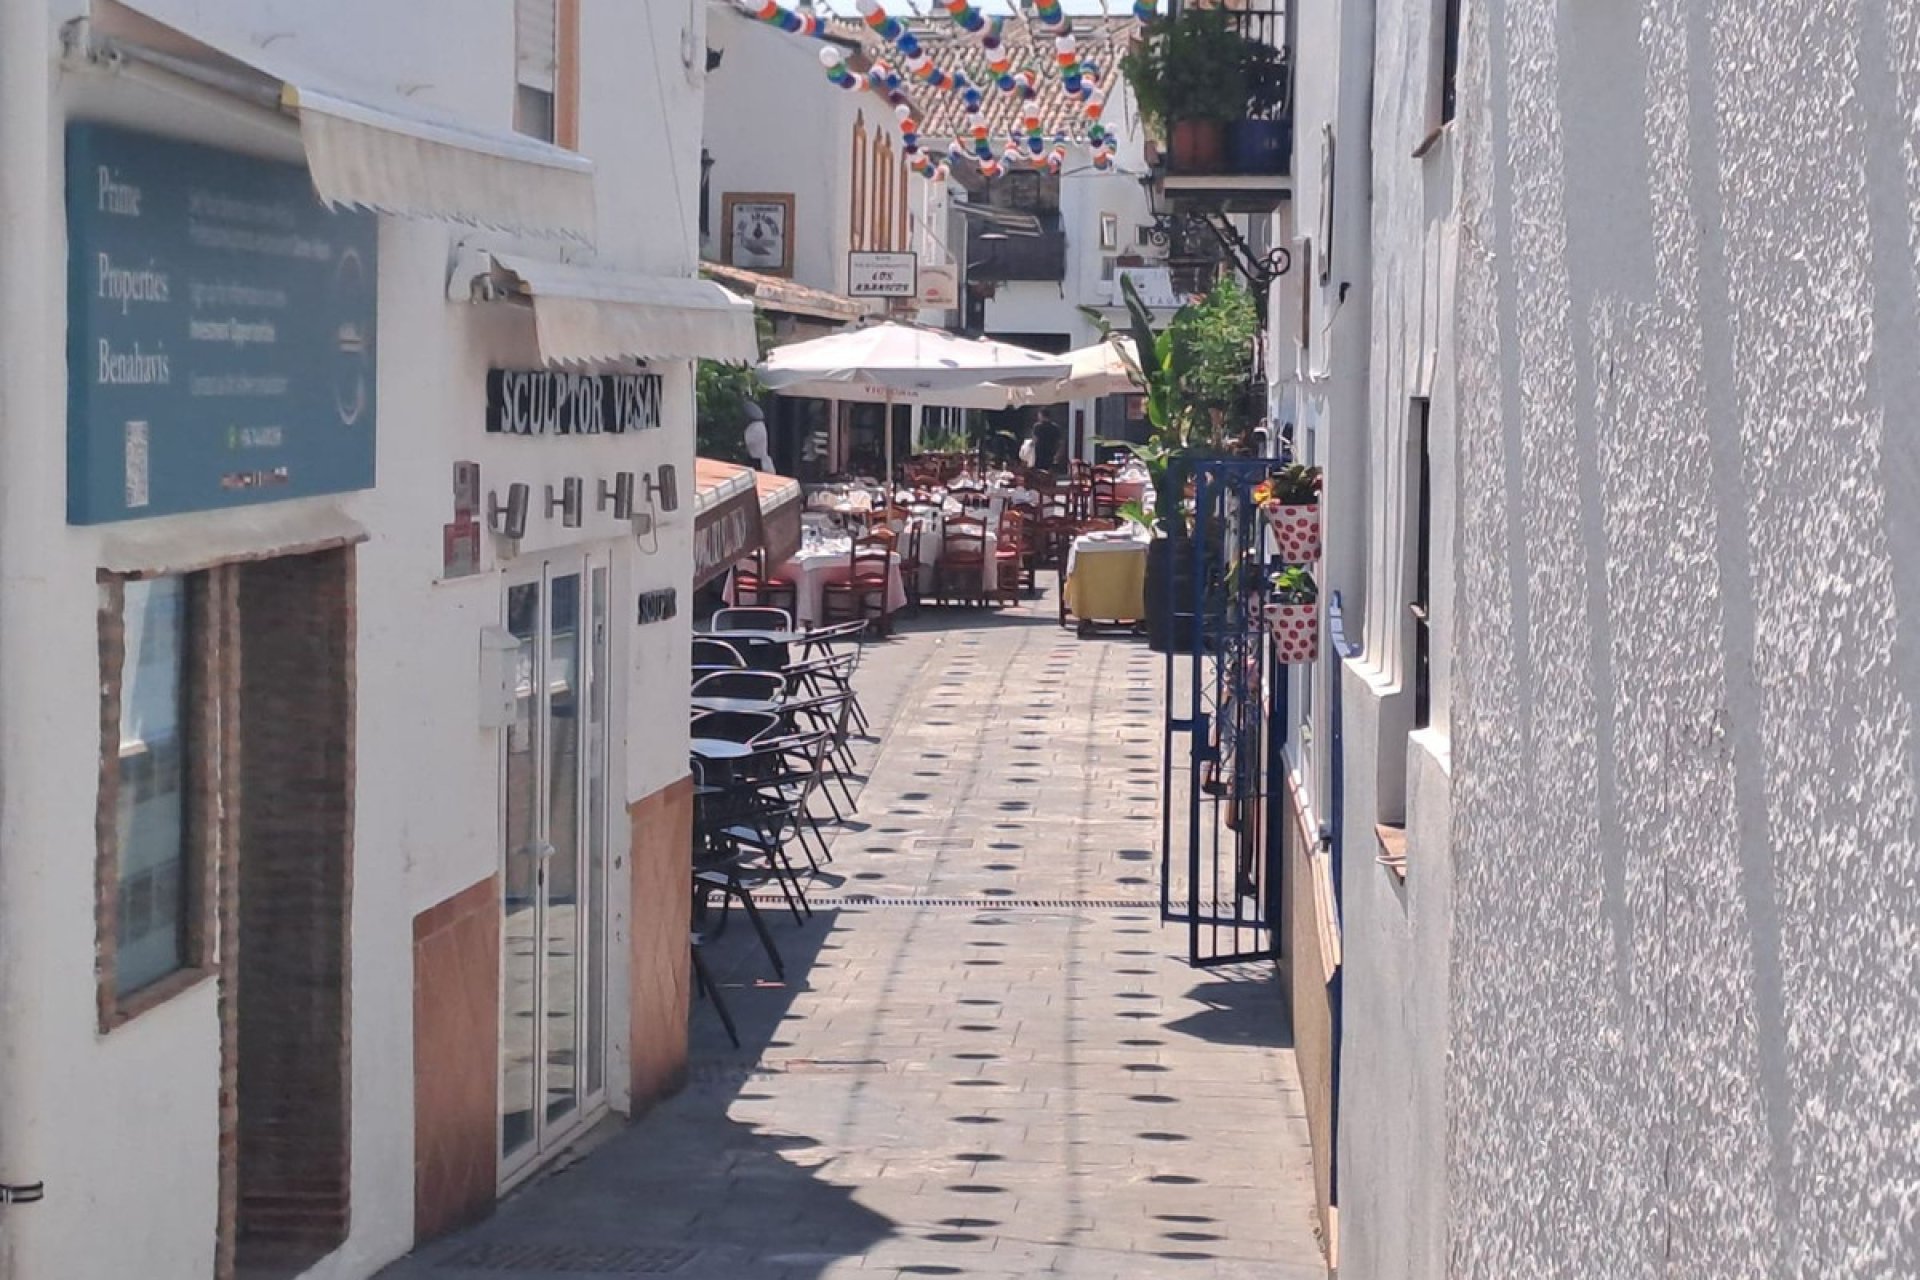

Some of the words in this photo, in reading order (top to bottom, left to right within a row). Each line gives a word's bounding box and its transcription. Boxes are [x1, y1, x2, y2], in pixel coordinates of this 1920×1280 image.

[98, 166, 141, 216] Prime
[98, 253, 170, 315] Properties
[501, 371, 603, 435] SCULPTOR
[613, 374, 662, 433] VESAN
